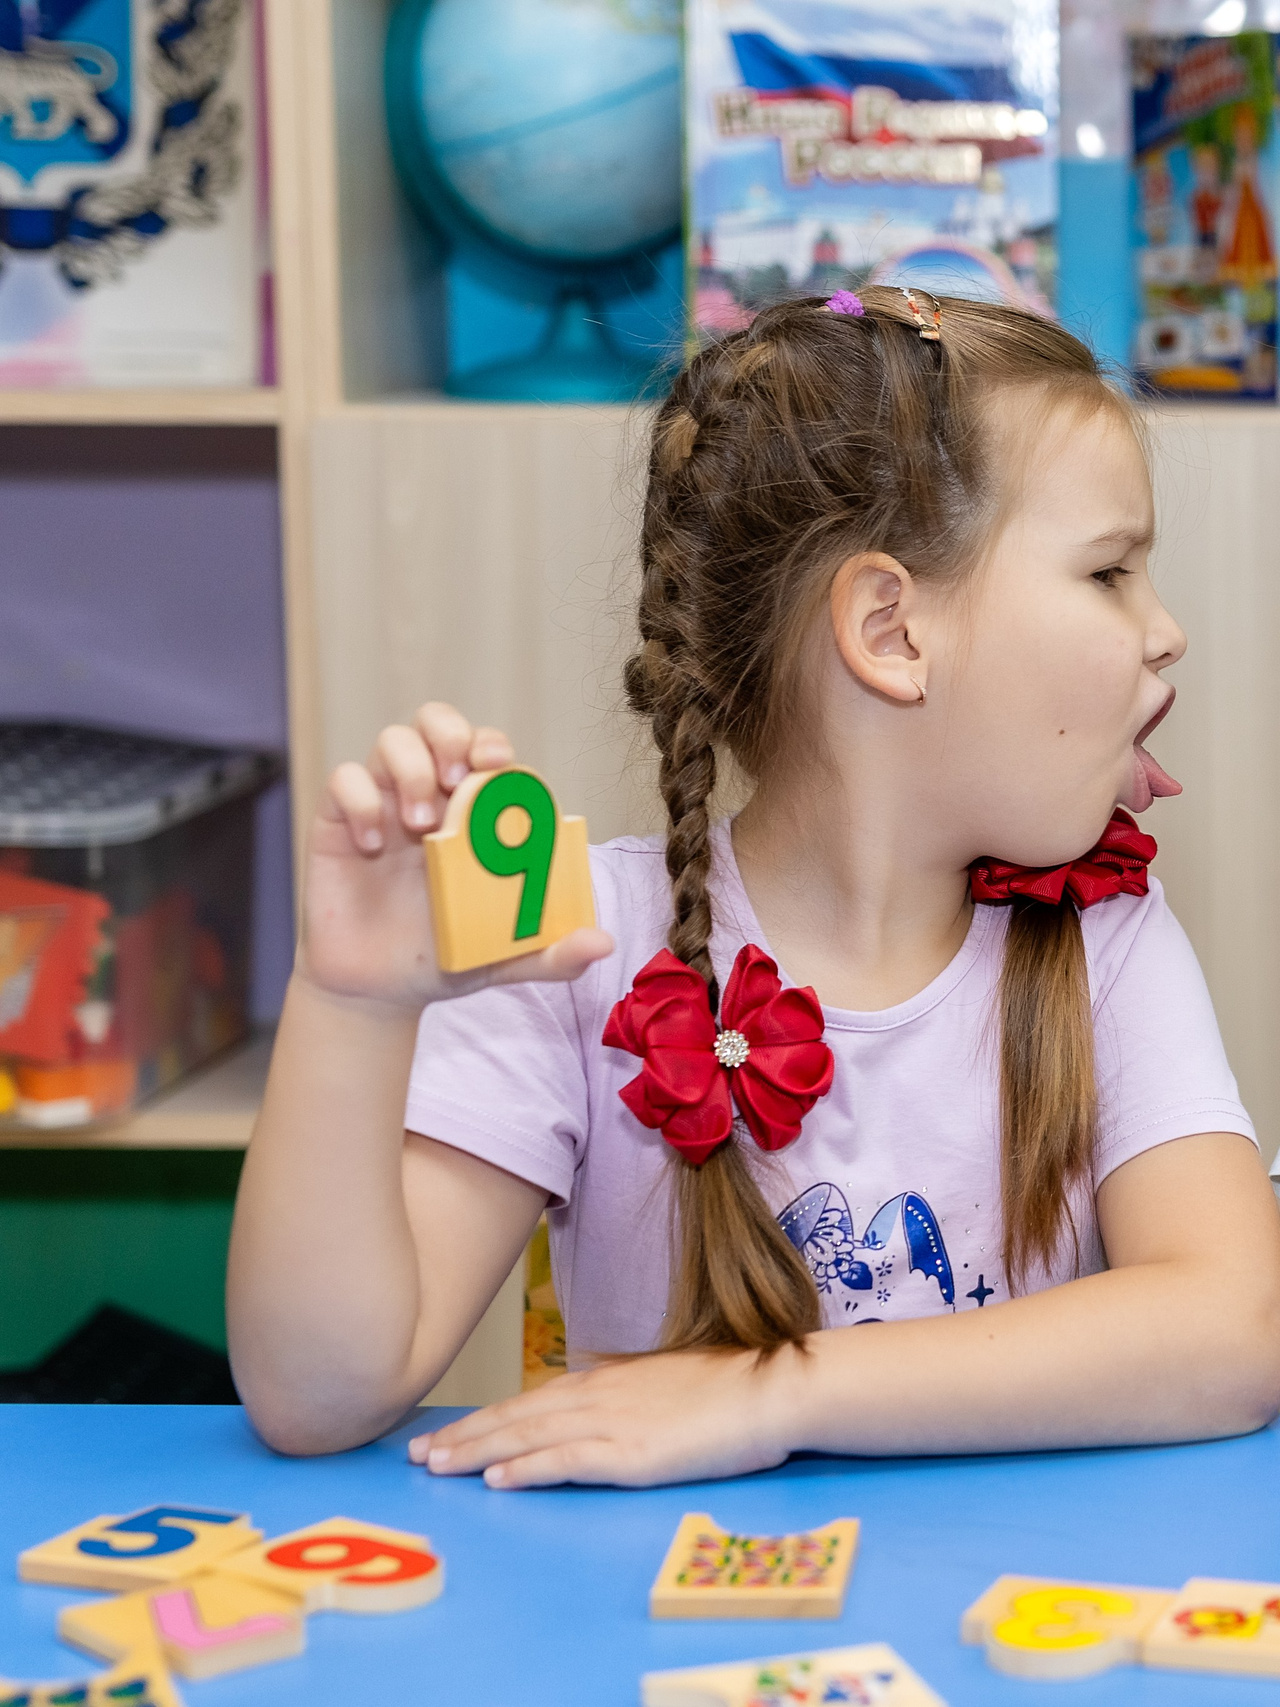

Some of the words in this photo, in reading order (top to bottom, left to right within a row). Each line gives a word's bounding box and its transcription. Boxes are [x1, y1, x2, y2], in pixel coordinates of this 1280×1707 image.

[469, 770, 557, 941] 9
[76, 1504, 243, 1559] 5
[993, 1584, 1135, 1651] 3
